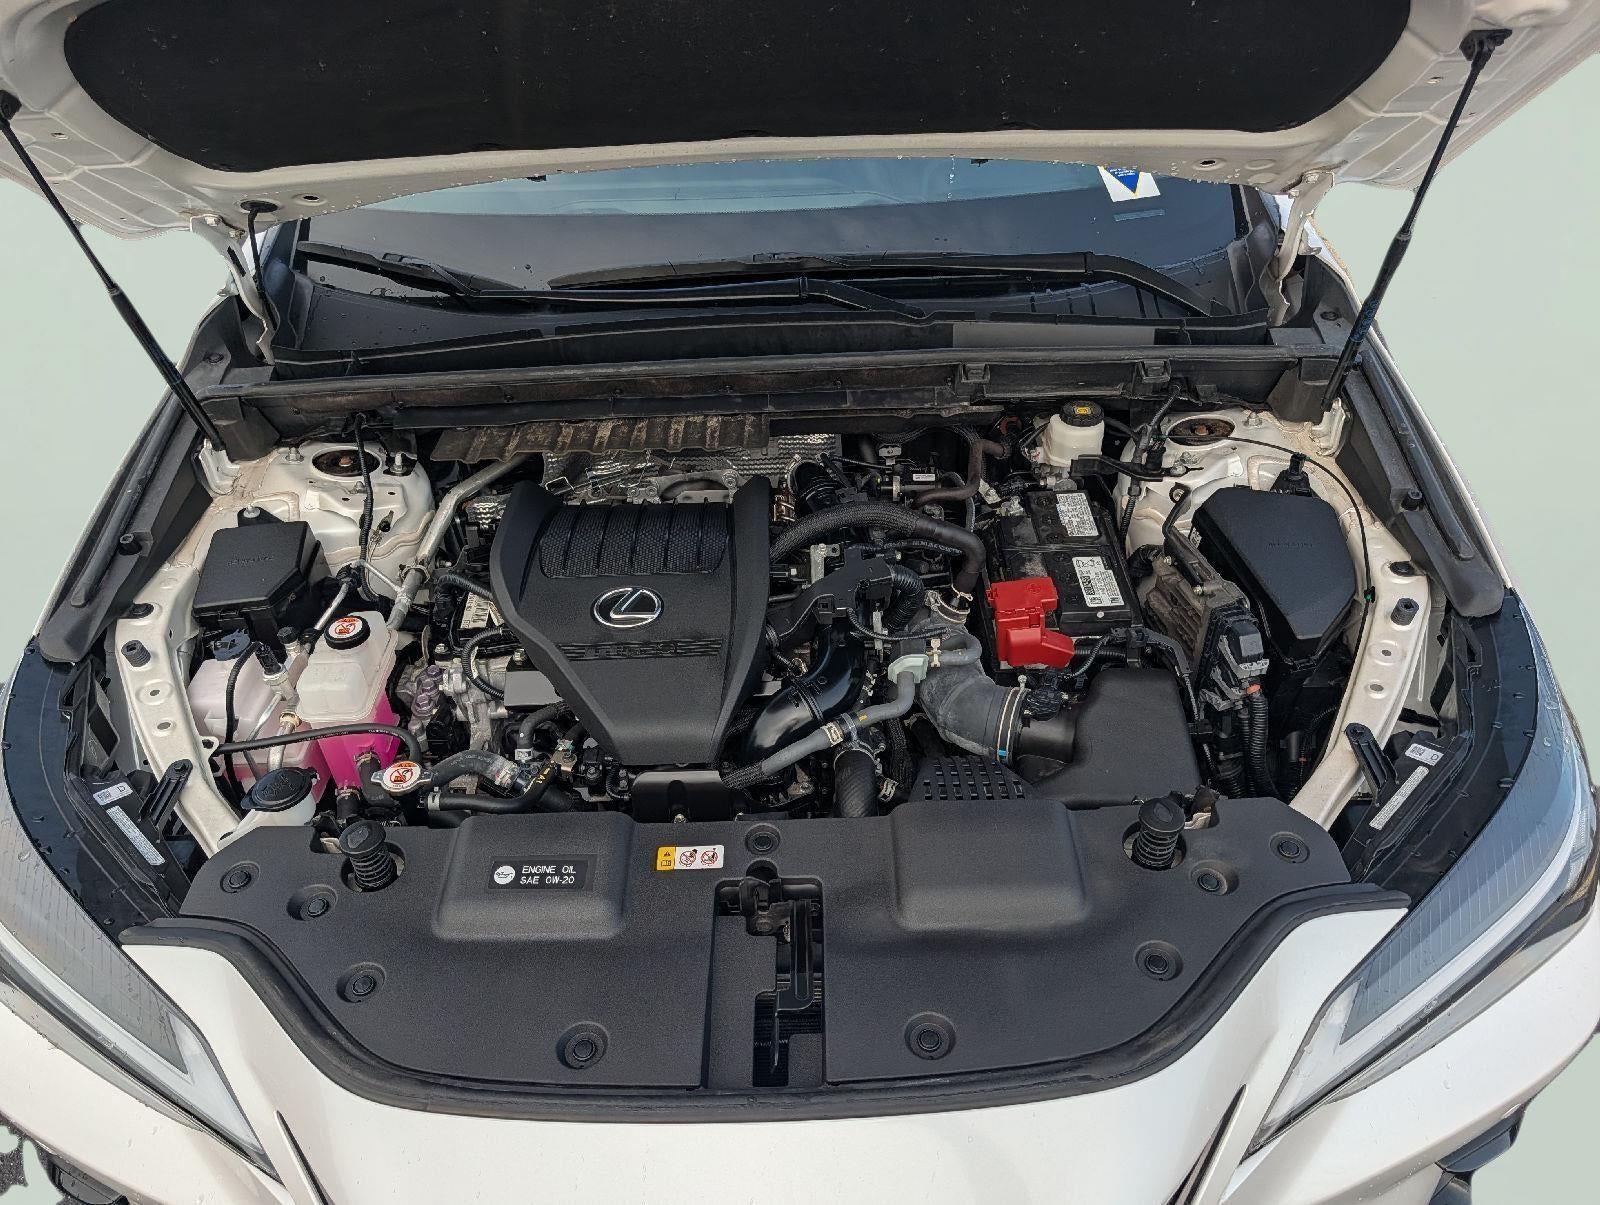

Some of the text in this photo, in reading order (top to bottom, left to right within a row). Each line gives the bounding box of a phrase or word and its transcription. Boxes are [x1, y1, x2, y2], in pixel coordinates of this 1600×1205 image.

[521, 865, 577, 874] ENGINE OIL
[519, 875, 575, 884] SAE 0W-20
